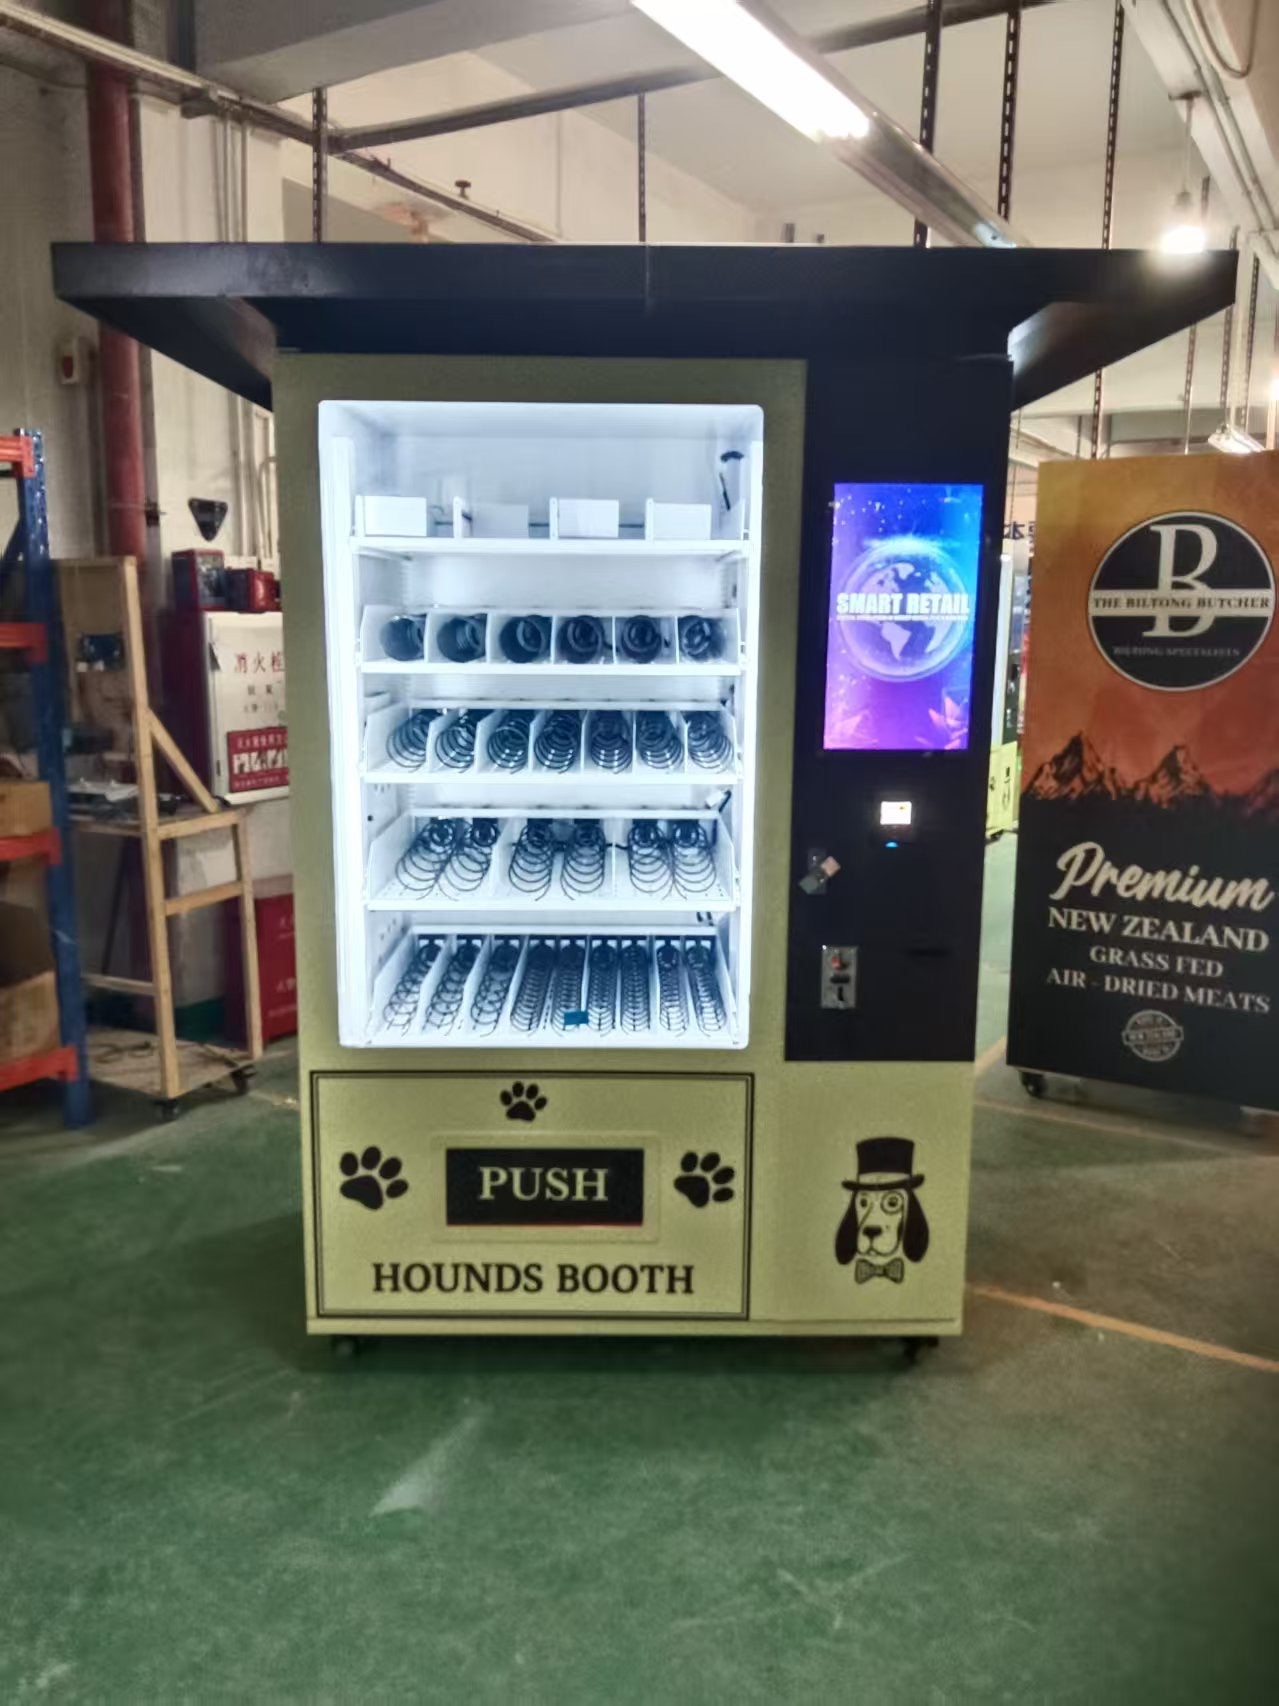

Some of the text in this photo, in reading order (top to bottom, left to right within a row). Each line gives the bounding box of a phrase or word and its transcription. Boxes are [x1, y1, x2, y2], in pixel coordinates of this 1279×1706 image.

[836, 592, 970, 614] SMART RETAIL
[1094, 597, 1270, 609] THE BILTONG BUTCHER
[1049, 841, 1275, 911] Premium
[1048, 906, 1270, 952] NEW ZEALAND
[1089, 945, 1224, 978] GRASS FED
[1046, 967, 1087, 988] AIR
[1104, 974, 1179, 1000] DRIED
[1184, 985, 1270, 1014] MEATS
[479, 1167, 609, 1201] PUSH
[373, 1262, 694, 1294] HOUNDS BOOTH
